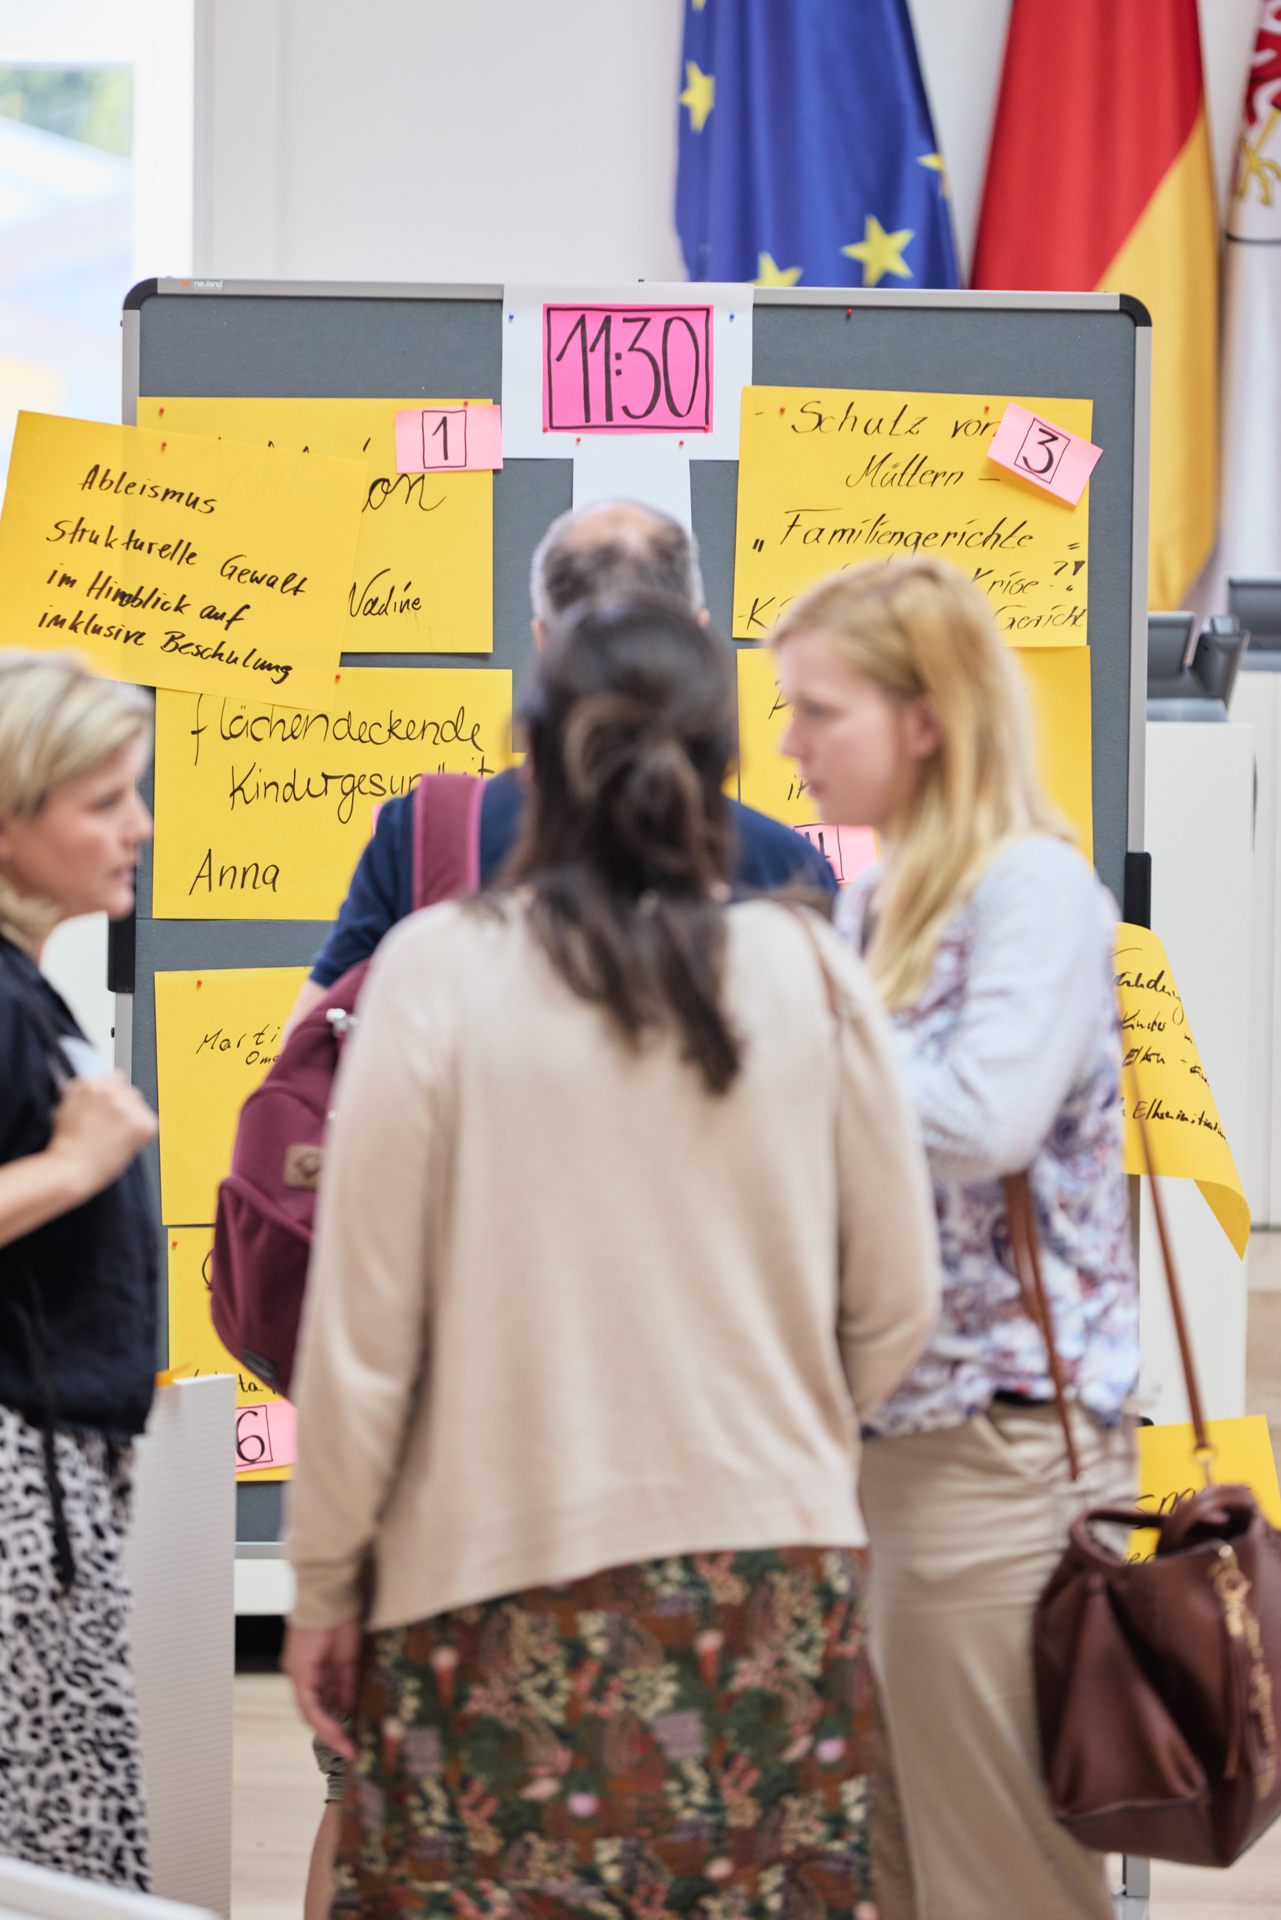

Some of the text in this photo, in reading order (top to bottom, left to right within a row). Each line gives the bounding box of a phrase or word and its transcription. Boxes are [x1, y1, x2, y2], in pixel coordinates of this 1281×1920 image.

[193, 280, 223, 288] neuland
[555, 313, 700, 423] 11:30
[431, 416, 449, 461] 1
[1021, 428, 1059, 474] 3
[78, 463, 218, 515] Ableismus
[845, 452, 964, 488] Müttern
[45, 516, 310, 597] Strukturelle Gewalt
[46, 562, 78, 589] im
[200, 603, 251, 632] auf
[160, 630, 294, 686] Beschulung
[188, 848, 281, 897] Anna
[237, 1410, 266, 1464] 6
